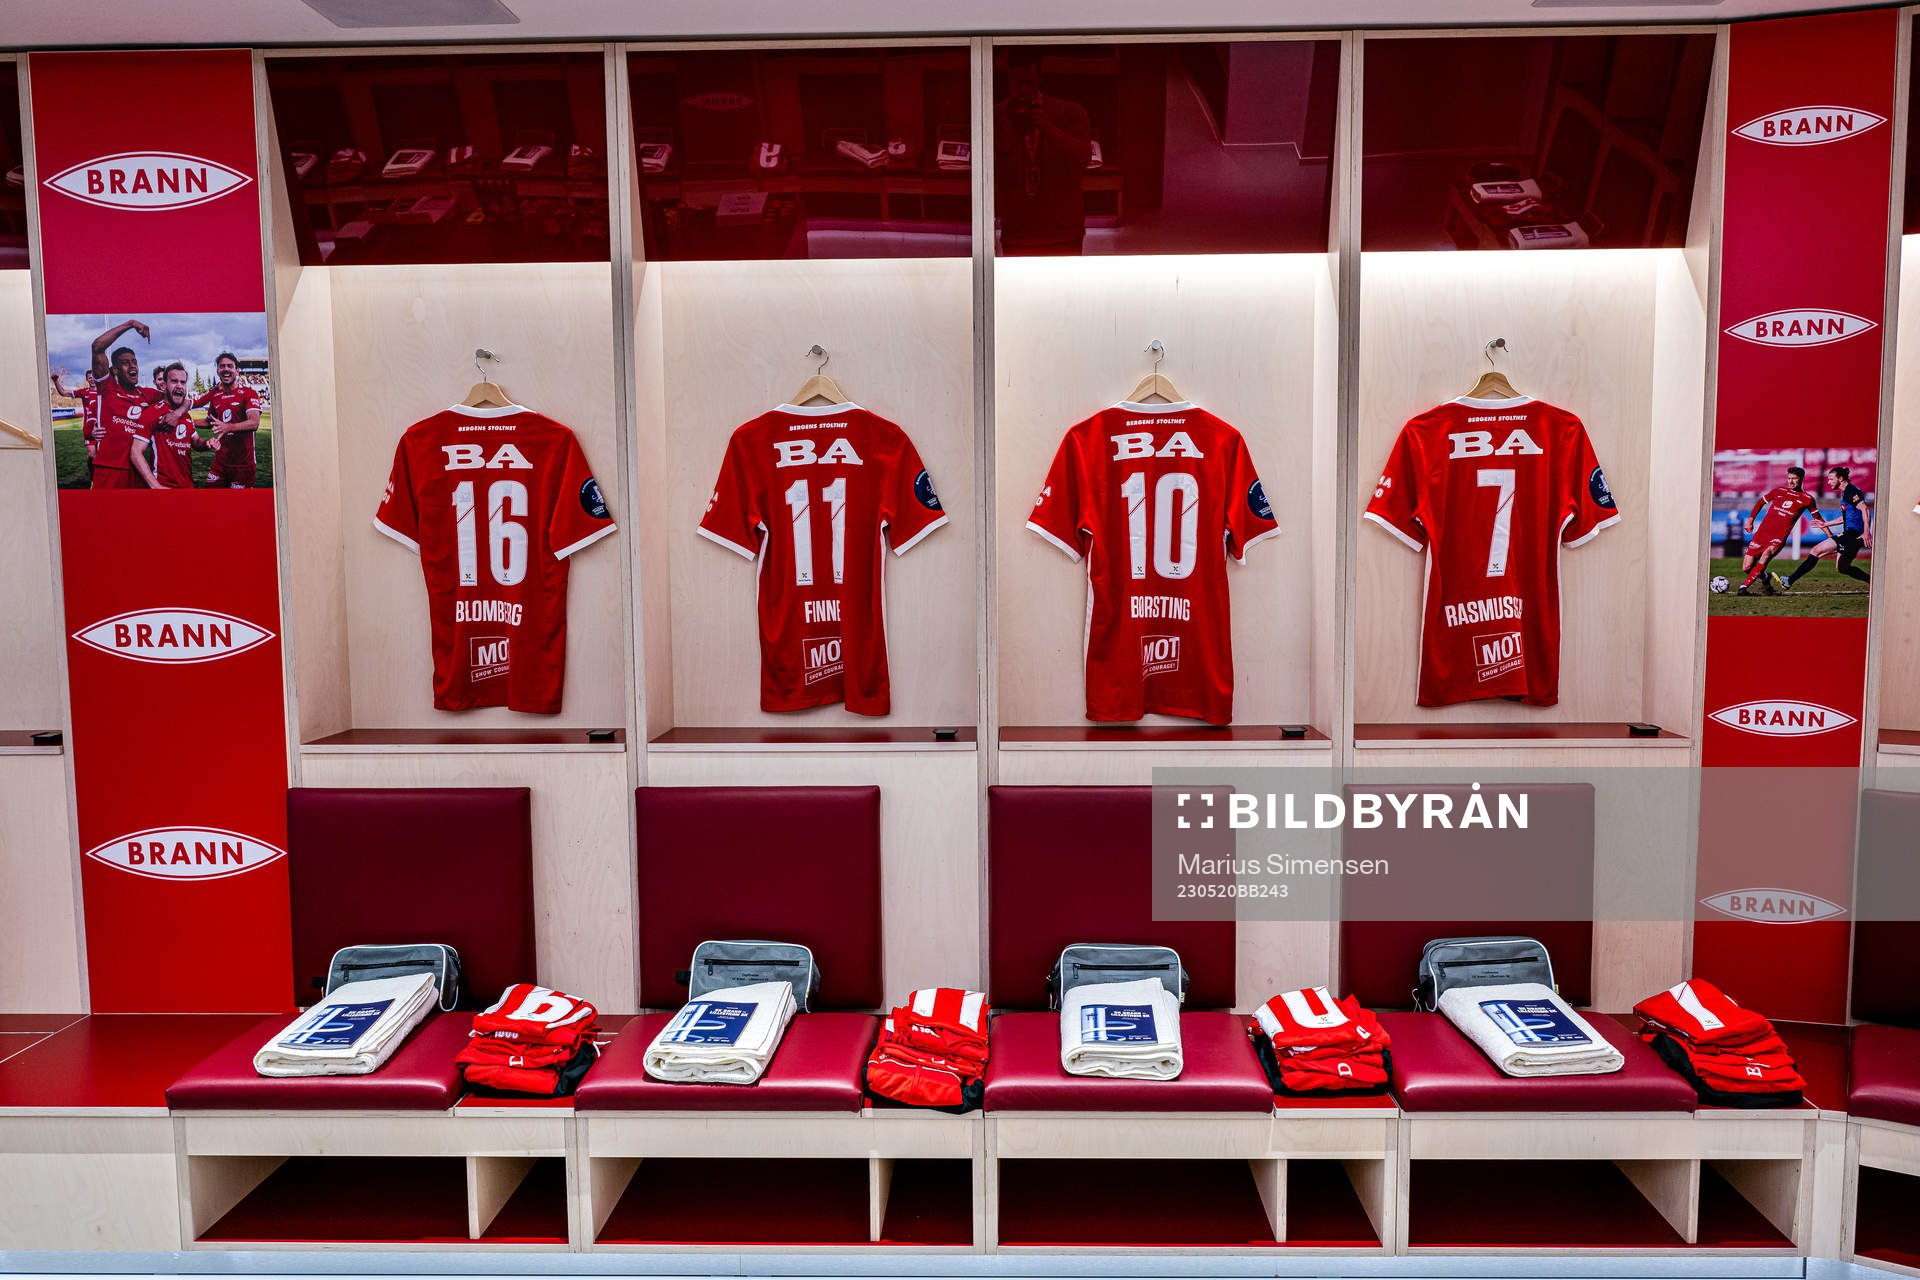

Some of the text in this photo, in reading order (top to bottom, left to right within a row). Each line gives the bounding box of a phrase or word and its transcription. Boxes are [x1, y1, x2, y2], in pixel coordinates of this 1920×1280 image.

[1763, 113, 1854, 138] BRANN
[86, 167, 208, 195] BRANN
[1755, 317, 1845, 338] BRANN
[789, 422, 848, 432] BERGENS STOLTHET
[1125, 418, 1155, 427] BERGENS
[1467, 415, 1497, 423] BERGENS
[441, 443, 534, 471] BA
[773, 438, 864, 469] BA
[1110, 431, 1205, 462] BA
[1448, 429, 1544, 460] BA
[451, 480, 529, 587] 16
[784, 477, 847, 586] 11
[1120, 471, 1199, 580] 10
[1476, 468, 1516, 578] 7
[455, 599, 523, 626] BLOMBERG
[114, 623, 232, 648] BRANN
[1481, 632, 1521, 665] MOT
[1143, 636, 1180, 665] MOT
[1738, 708, 1825, 728] BRANN
[127, 841, 244, 865] BRANN
[1729, 895, 1816, 917] BRANN
